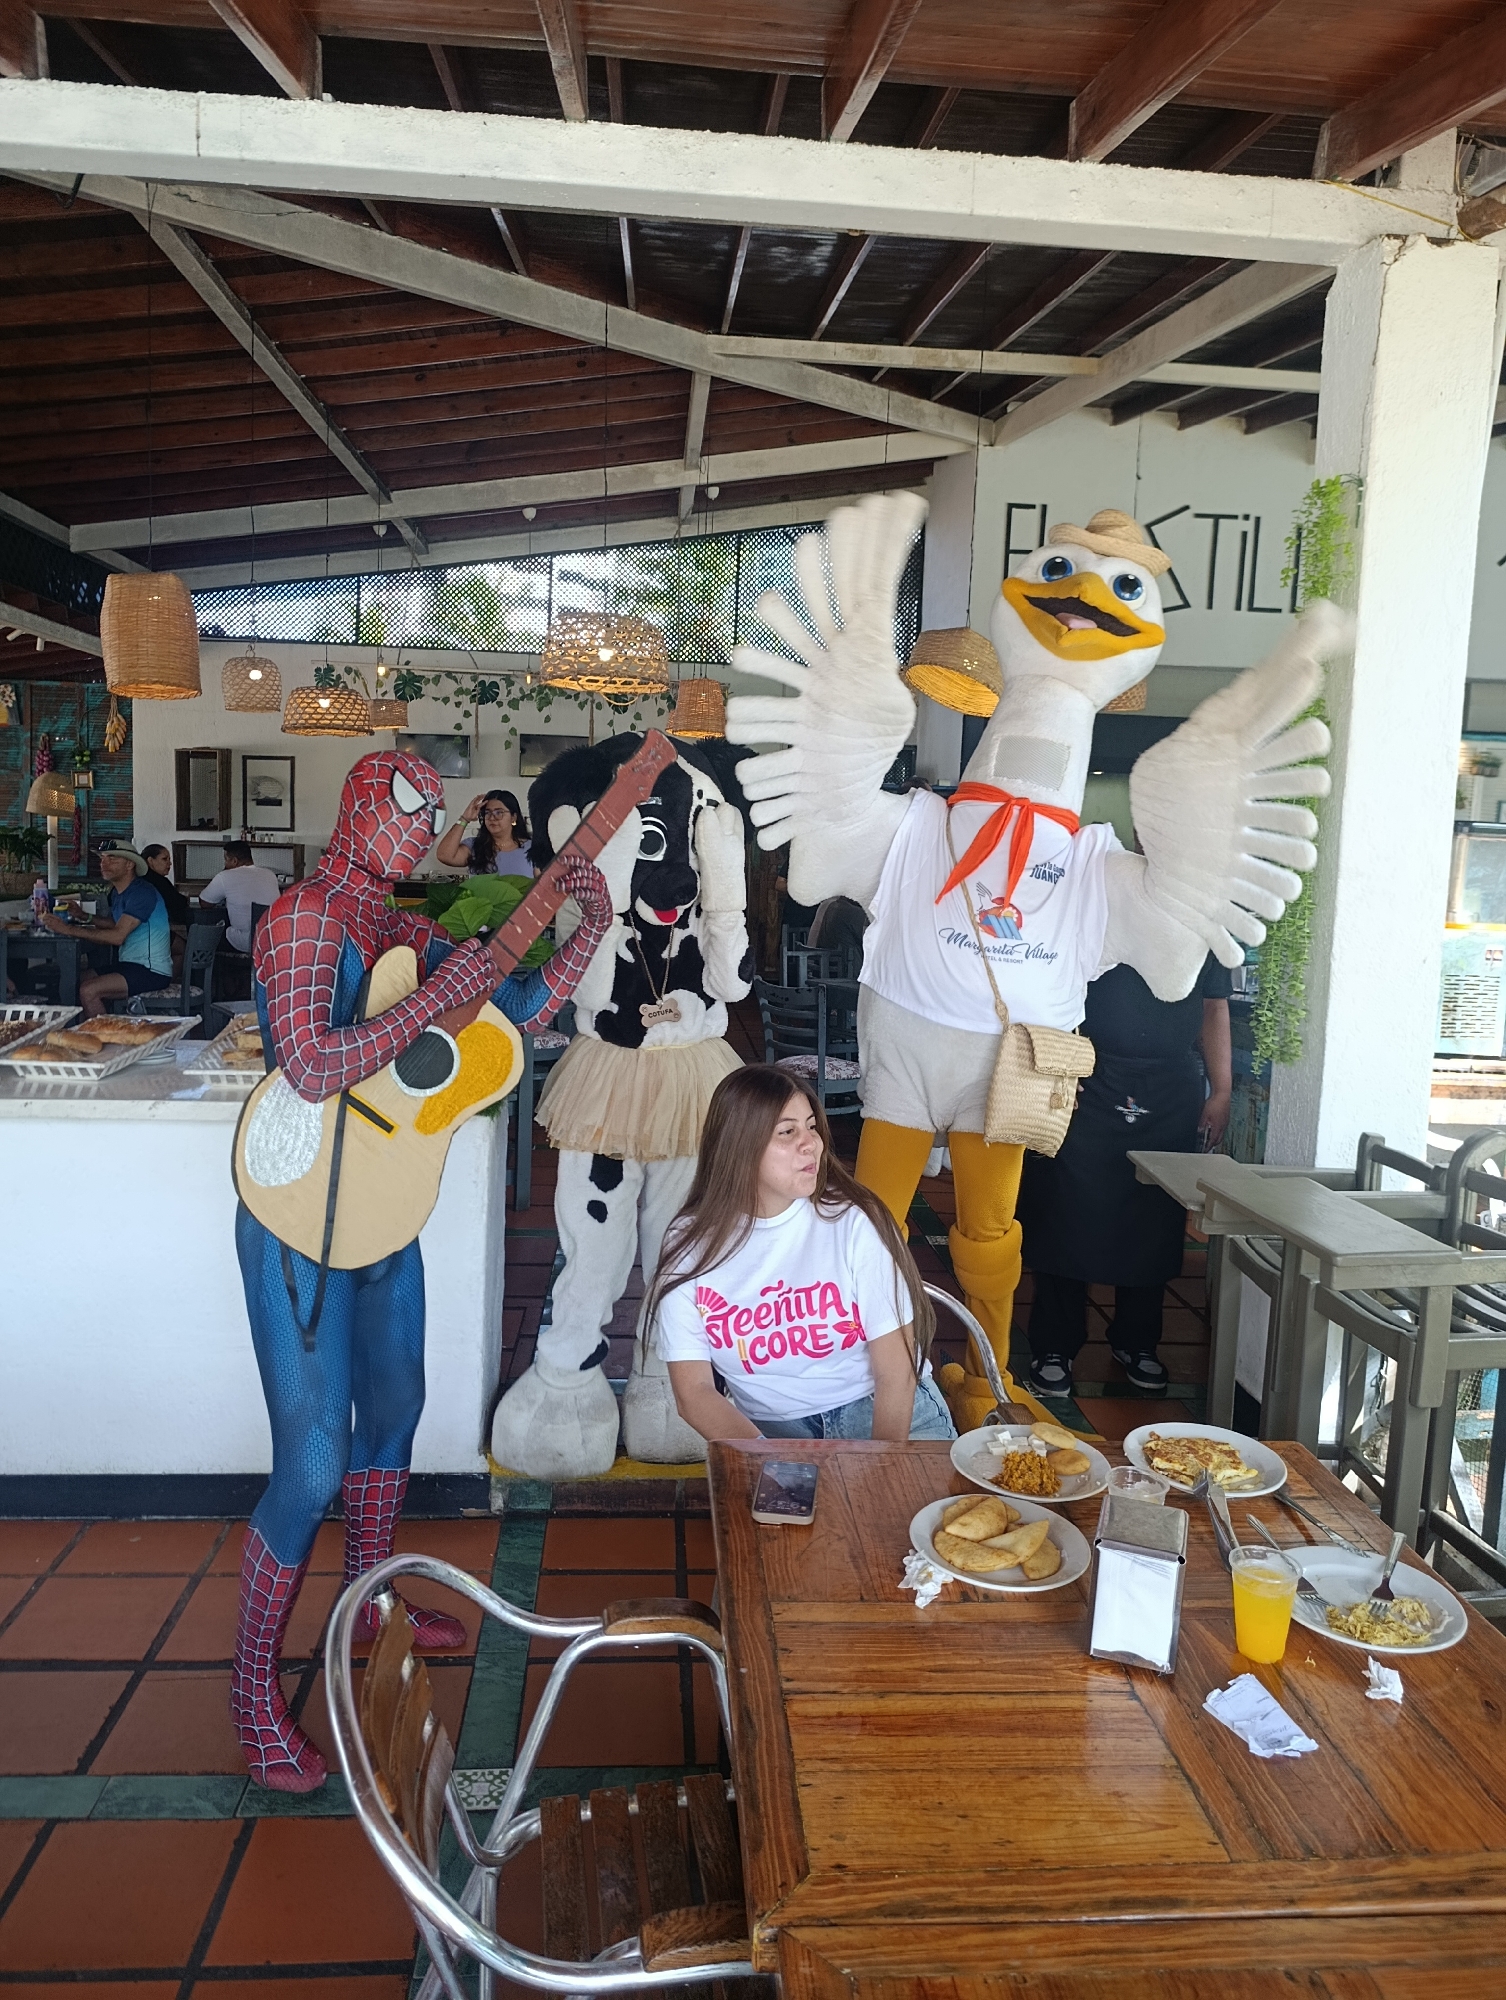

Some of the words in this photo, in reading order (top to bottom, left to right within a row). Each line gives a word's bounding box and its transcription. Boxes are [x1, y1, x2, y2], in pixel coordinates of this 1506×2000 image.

[938, 927, 1017, 955] Margarita
[1012, 942, 1059, 965] Village
[1003, 957, 1023, 965] RESORT
[648, 1009, 673, 1018] COTUFA
[749, 1323, 835, 1367] CORE
